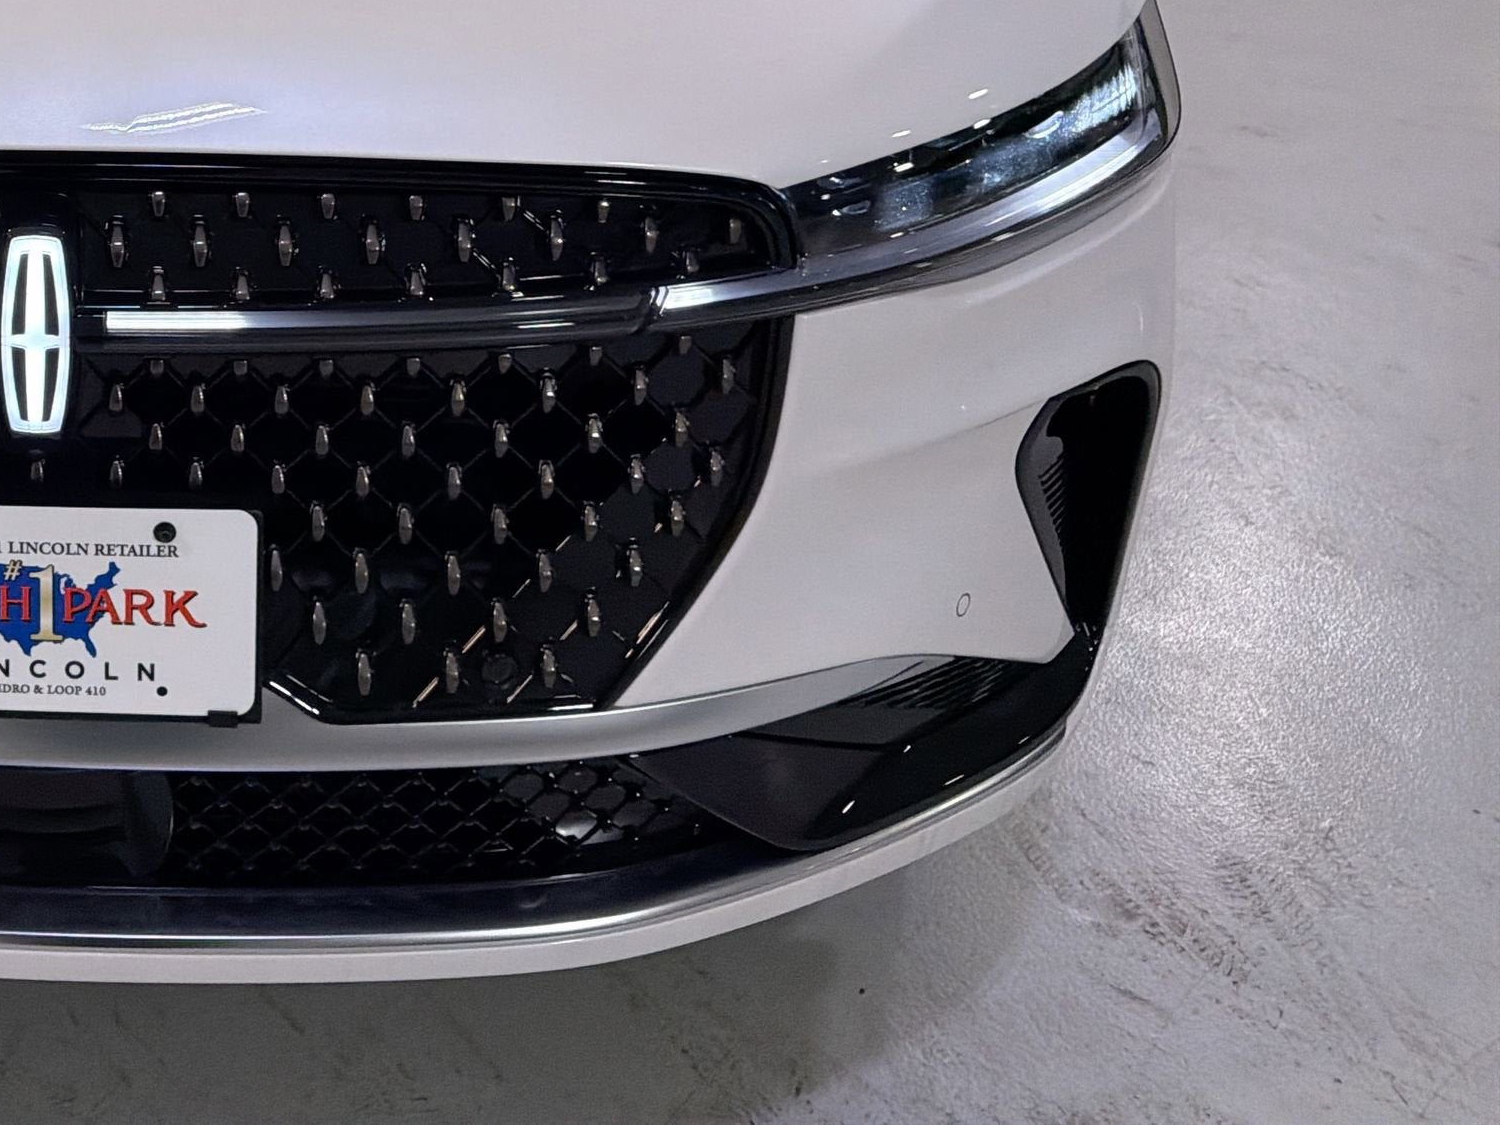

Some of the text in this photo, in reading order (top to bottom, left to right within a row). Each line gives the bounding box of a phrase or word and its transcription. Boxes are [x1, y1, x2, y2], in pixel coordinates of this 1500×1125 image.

[8, 541, 89, 556] LINCOLN
[94, 543, 180, 558] RETAILER
[62, 586, 208, 629] PARK
[33, 684, 44, 695] &
[47, 684, 83, 696] LOOP
[85, 686, 107, 697] 410
